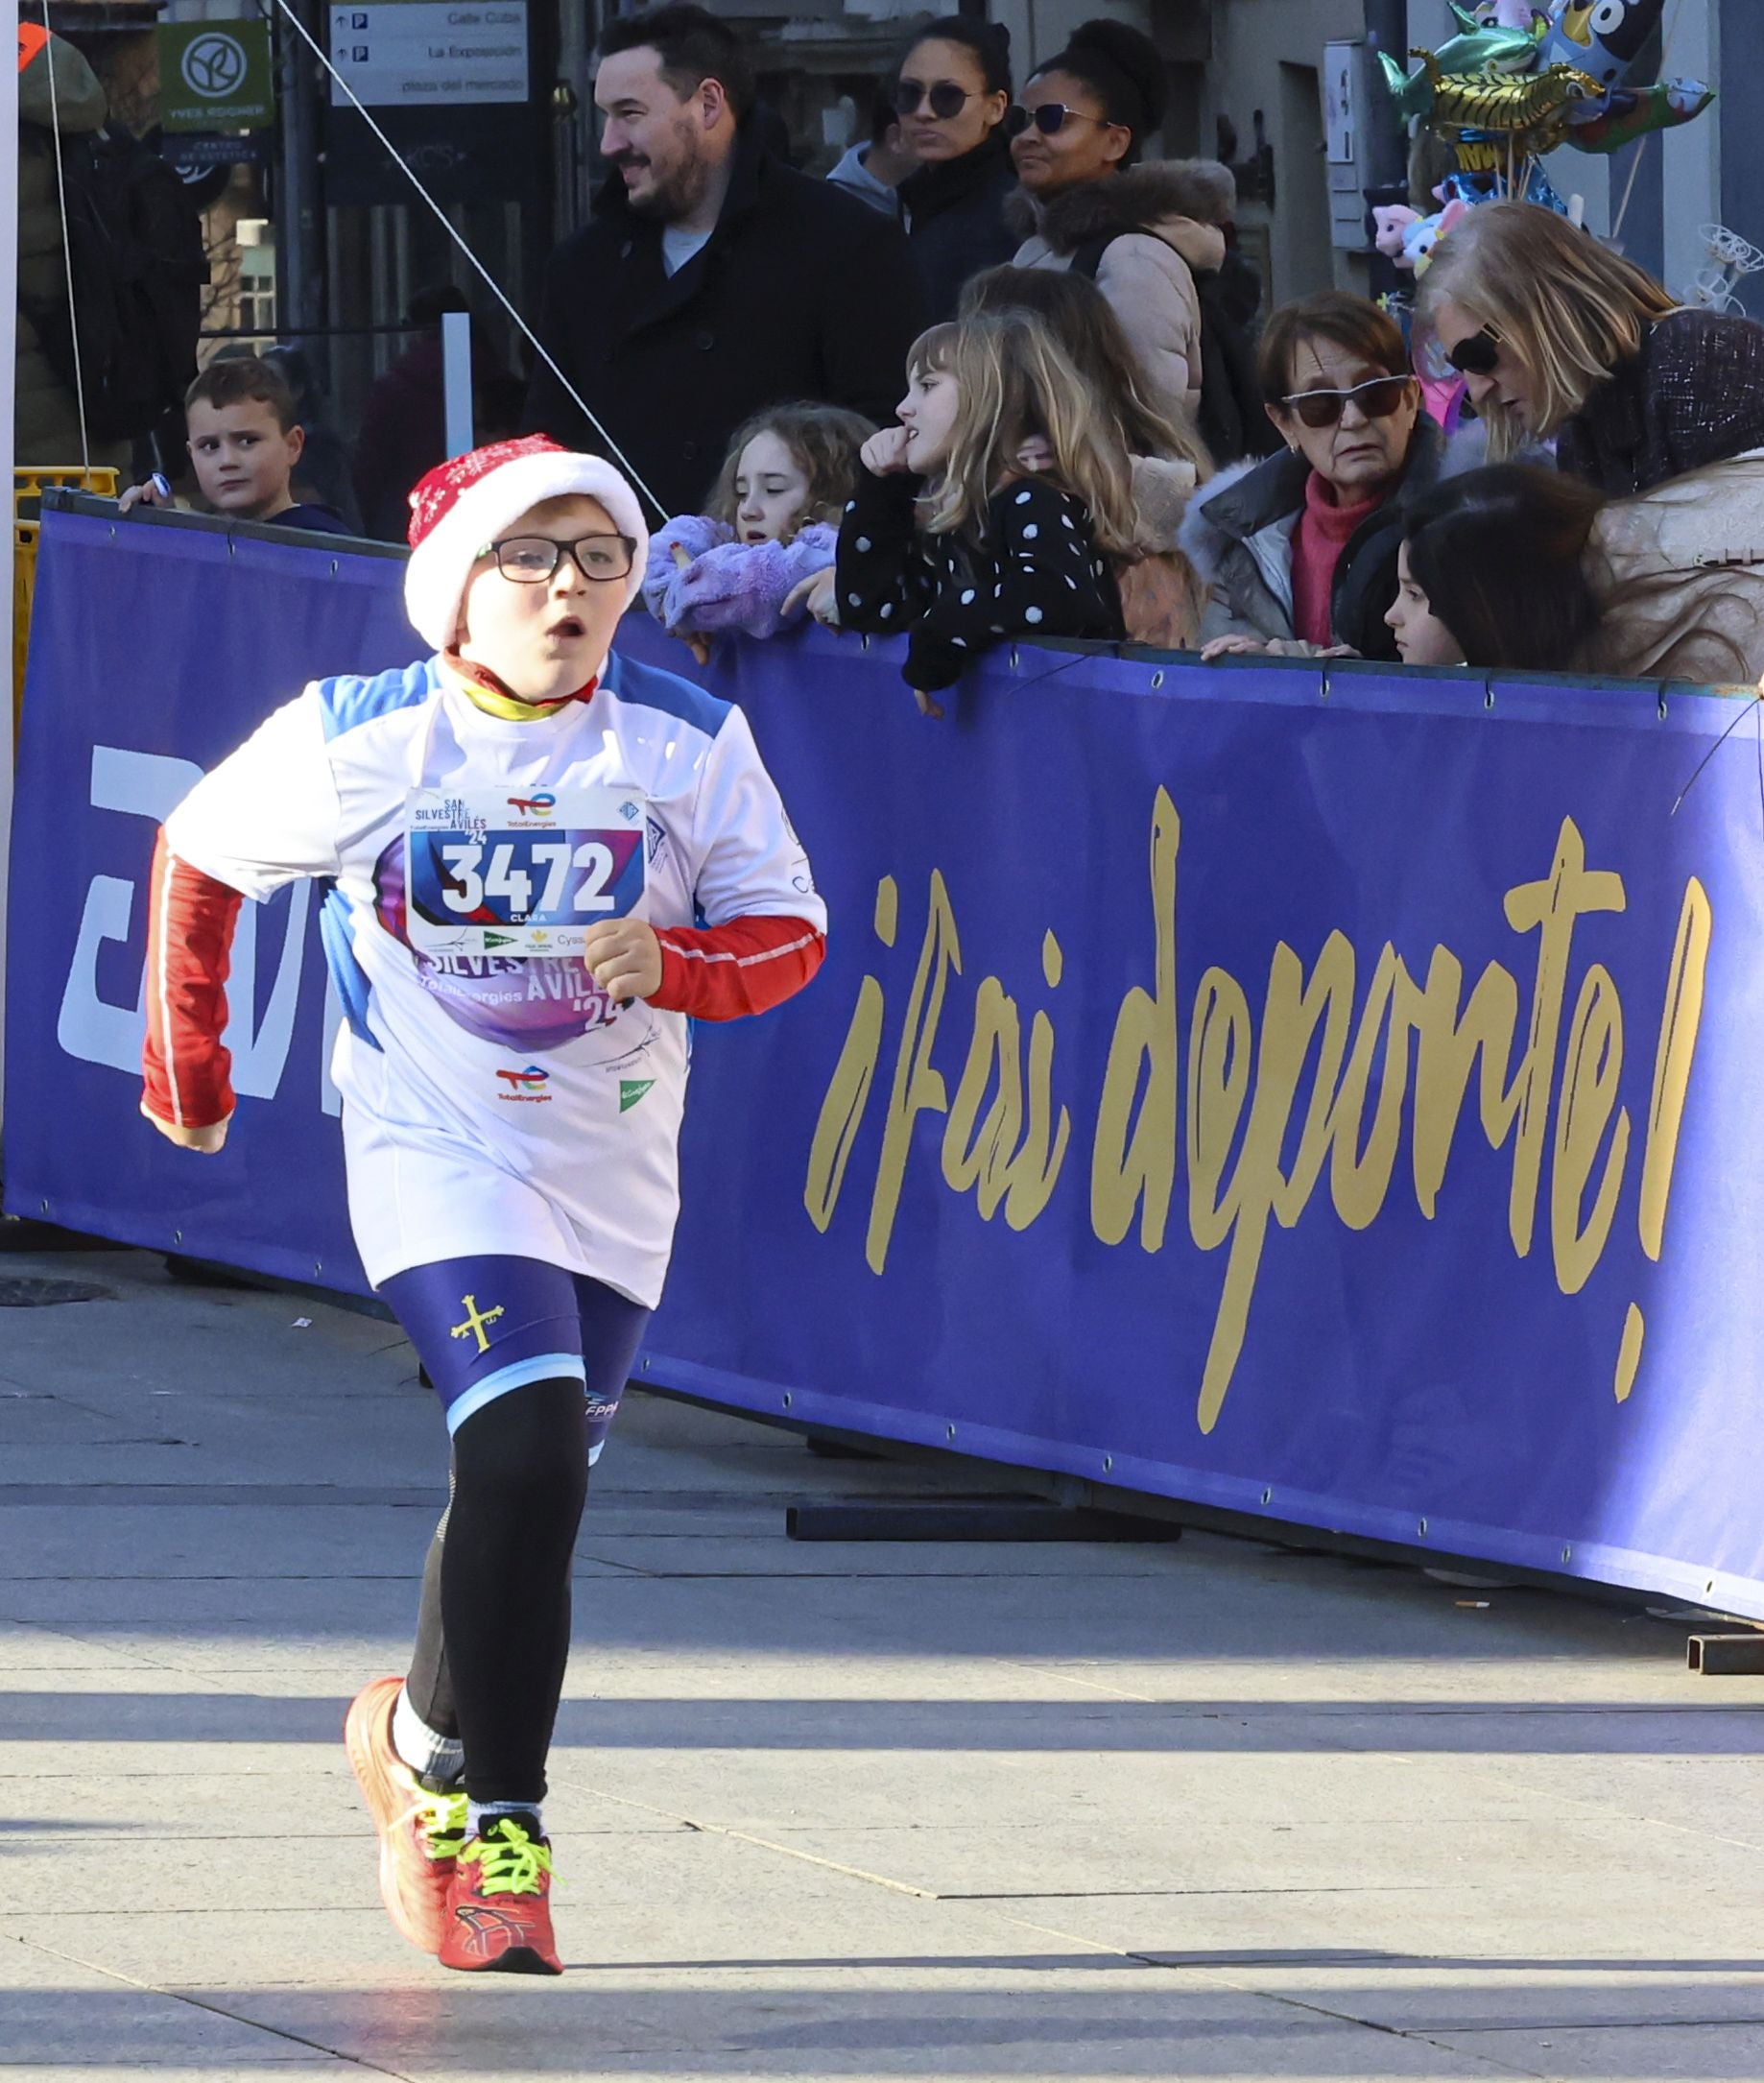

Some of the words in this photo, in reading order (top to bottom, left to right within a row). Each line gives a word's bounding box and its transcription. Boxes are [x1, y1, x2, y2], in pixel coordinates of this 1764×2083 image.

[428, 47, 445, 58] La
[444, 799, 465, 808] SAN
[415, 808, 470, 821] SILVESTRE
[507, 820, 557, 829] TotalEnergies
[442, 842, 615, 913] 3472
[511, 913, 548, 922] CLARA
[557, 934, 586, 946] Cyss
[497, 1092, 553, 1103] TotalEnergies
[1090, 783, 1712, 1436] deporte!
